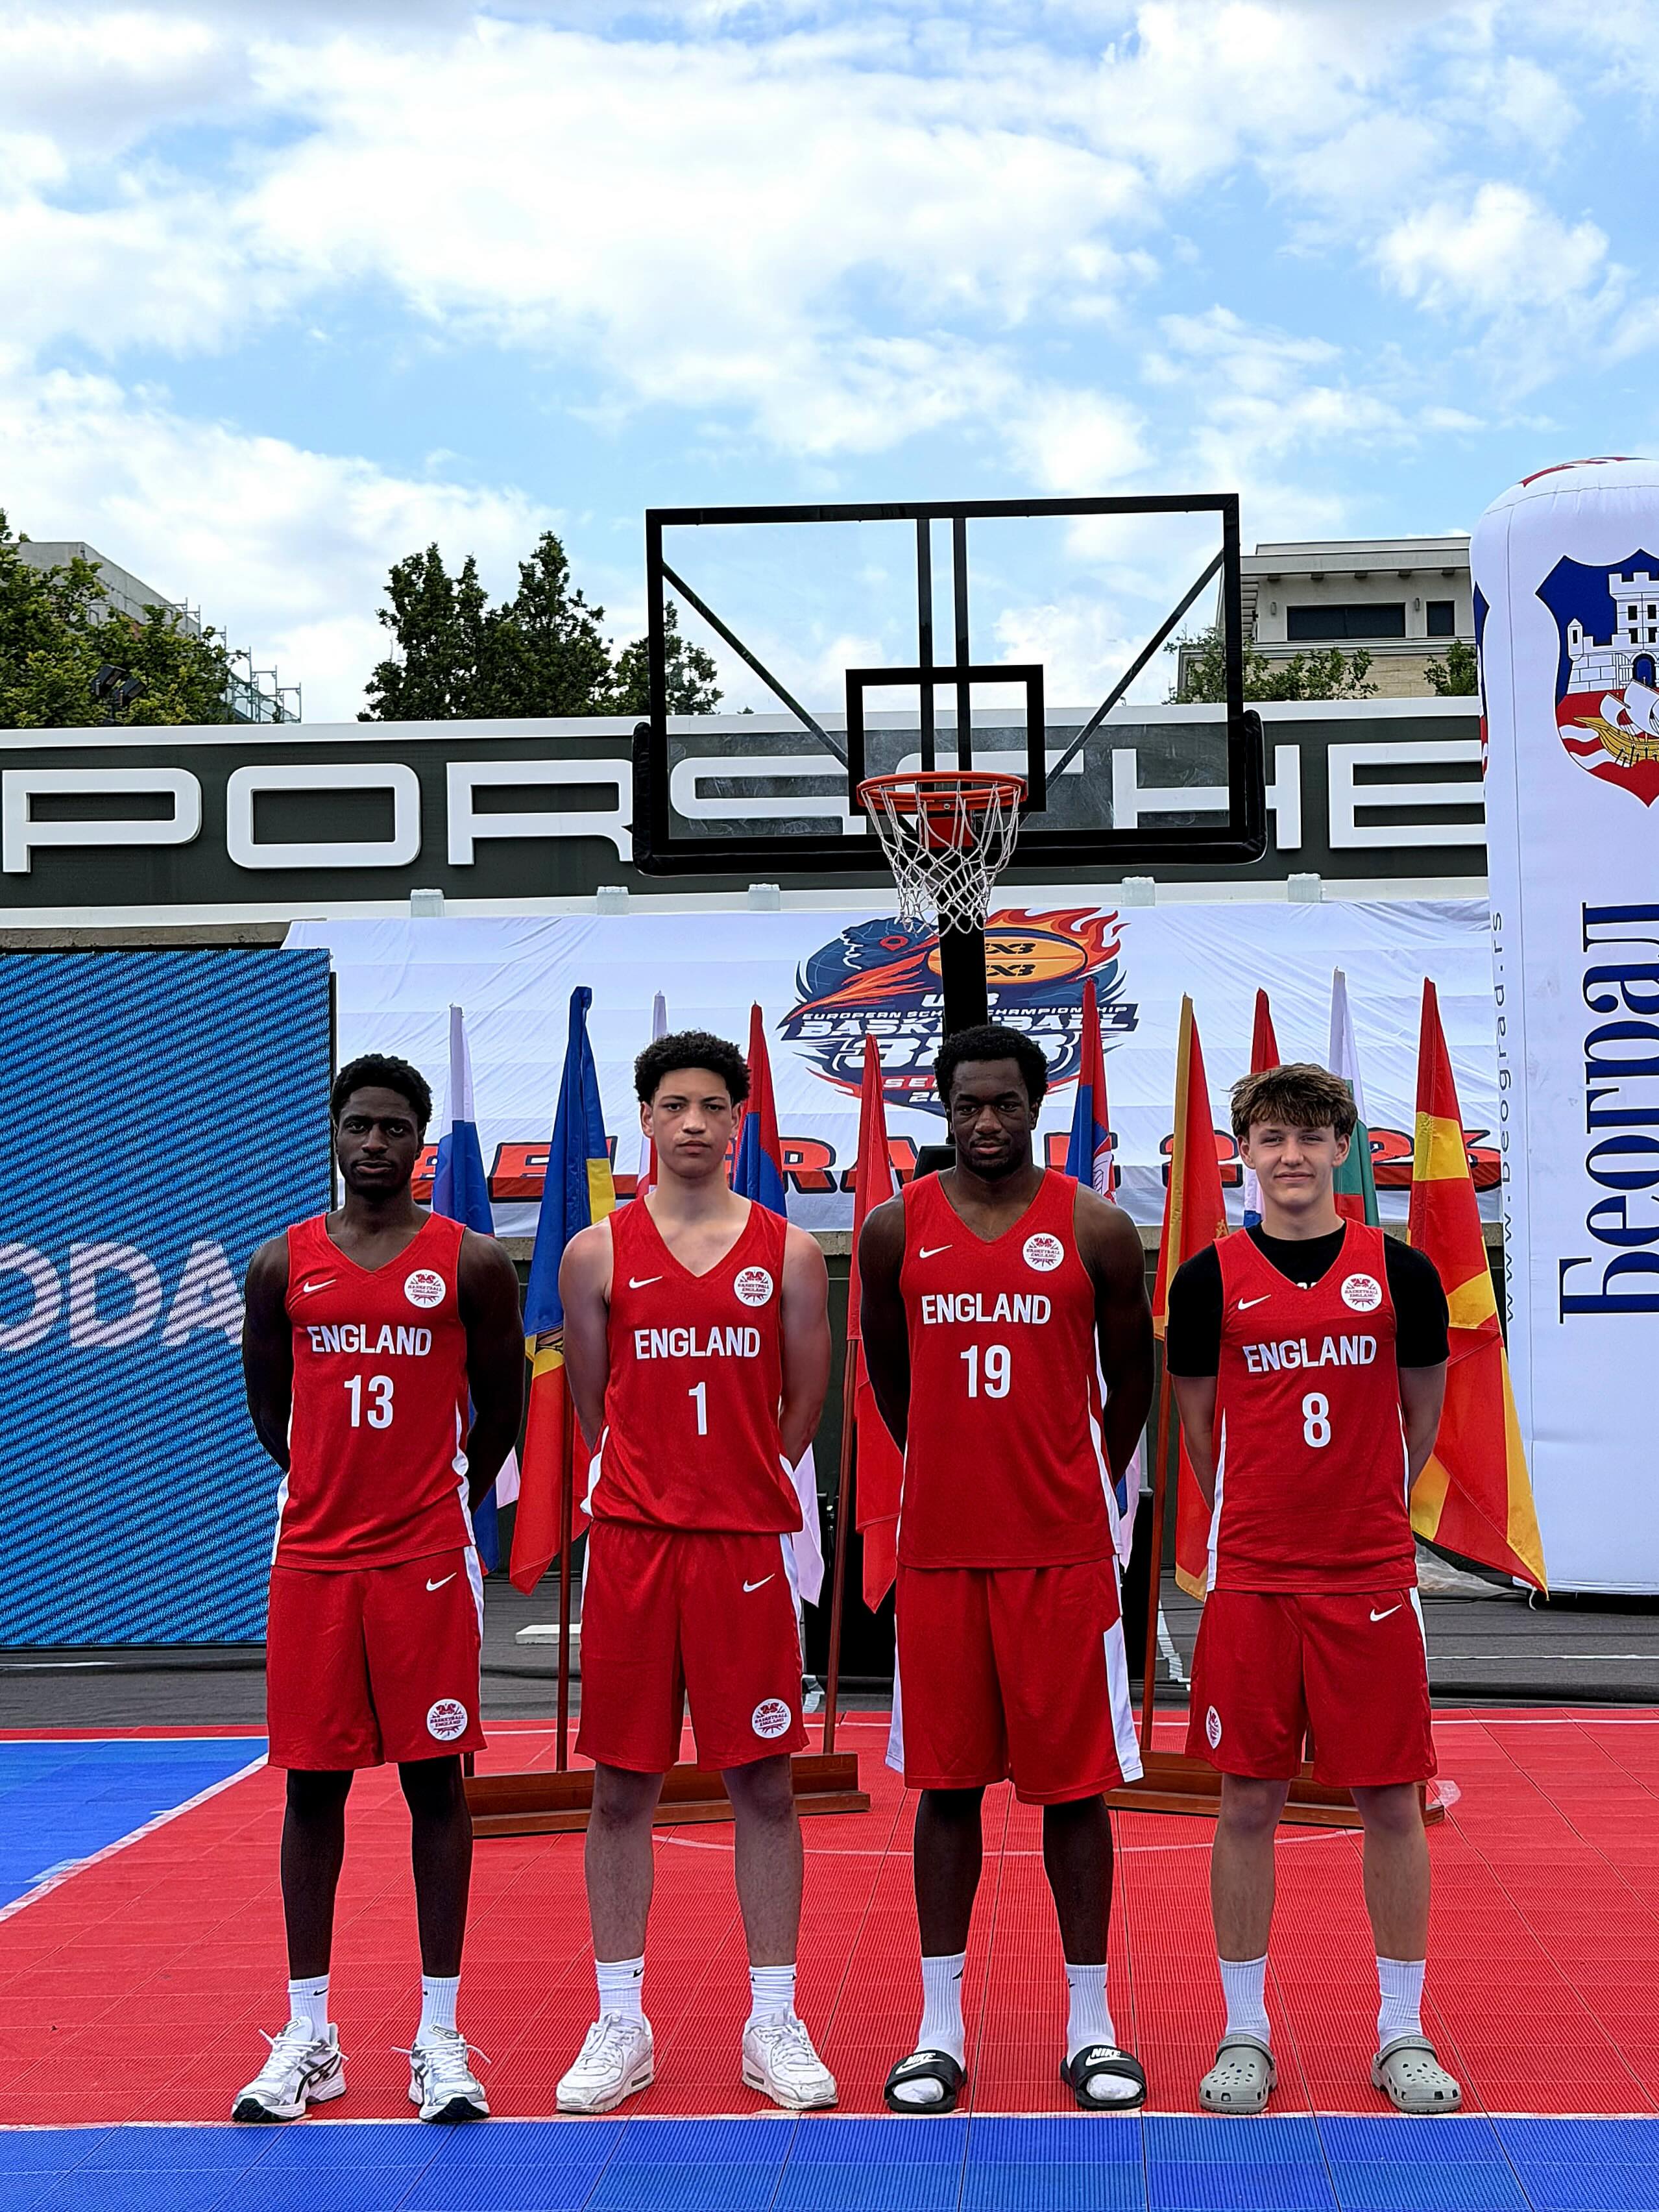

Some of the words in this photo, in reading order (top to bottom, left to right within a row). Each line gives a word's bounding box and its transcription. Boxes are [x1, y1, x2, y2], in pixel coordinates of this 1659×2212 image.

[801, 1011, 902, 1021] EUROPEAN
[988, 1006, 1128, 1016] CHAMPIONHIP
[921, 1293, 1051, 1325] ENGLAND
[307, 1324, 432, 1356] ENGLAND
[634, 1326, 760, 1360] ENGLAND
[1242, 1335, 1377, 1373] ENGLAND
[960, 1344, 1011, 1398] 19
[344, 1374, 394, 1429] 13
[688, 1381, 708, 1436] 1
[1302, 1392, 1331, 1448] 8
[903, 2053, 936, 2067] NIKE
[1091, 2048, 1121, 2058] NIKE
